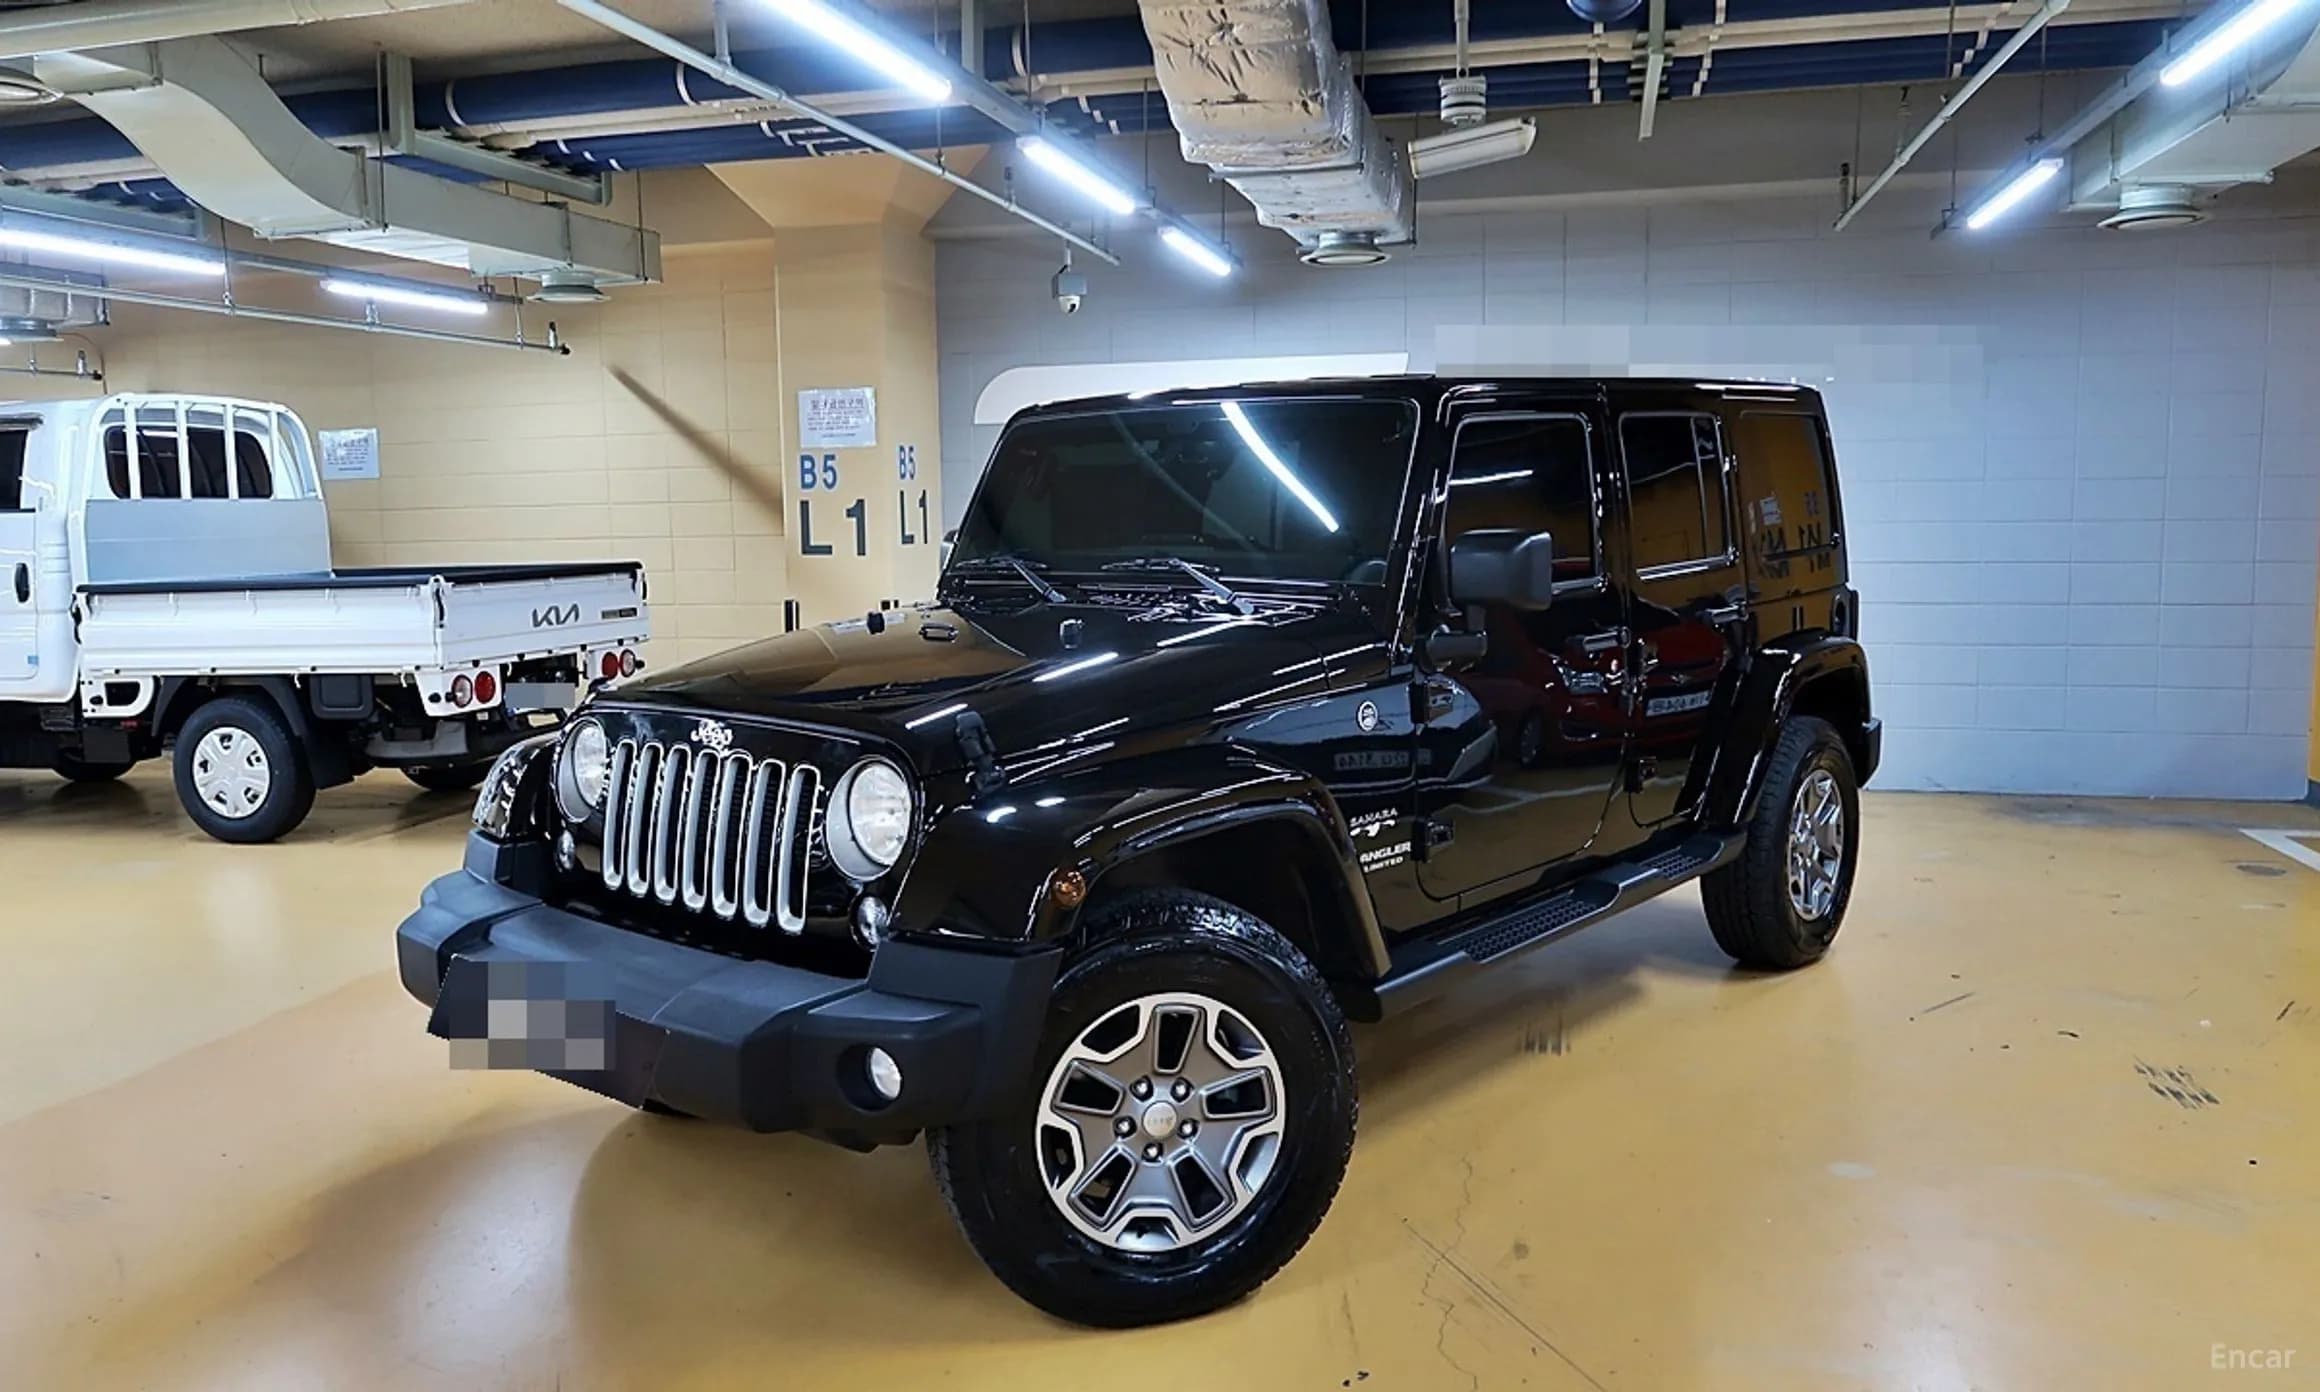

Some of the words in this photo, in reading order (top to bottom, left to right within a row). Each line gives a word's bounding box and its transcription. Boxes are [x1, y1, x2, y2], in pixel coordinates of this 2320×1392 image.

[800, 454, 837, 490] B5
[900, 446, 916, 480] B5
[800, 499, 866, 557] L1
[900, 489, 928, 545] L1
[532, 602, 580, 628] KIA
